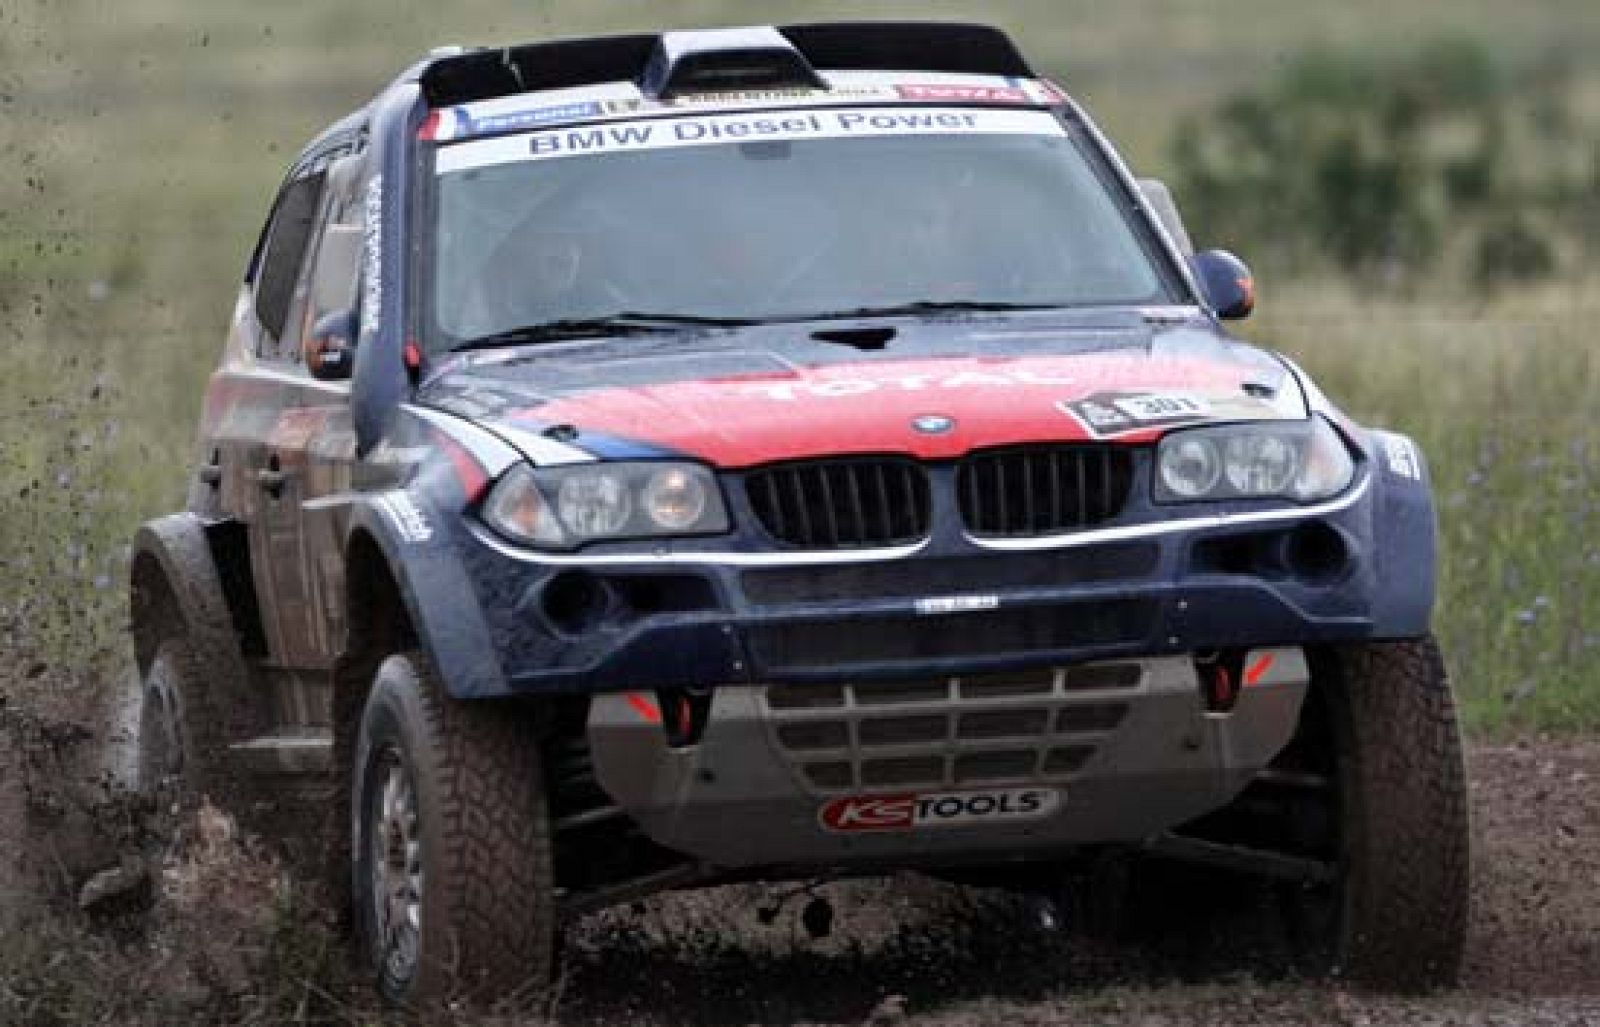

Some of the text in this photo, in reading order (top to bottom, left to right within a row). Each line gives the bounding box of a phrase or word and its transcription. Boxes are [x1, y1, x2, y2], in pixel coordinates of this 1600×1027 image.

[529, 113, 977, 154] BMW Diesel Power
